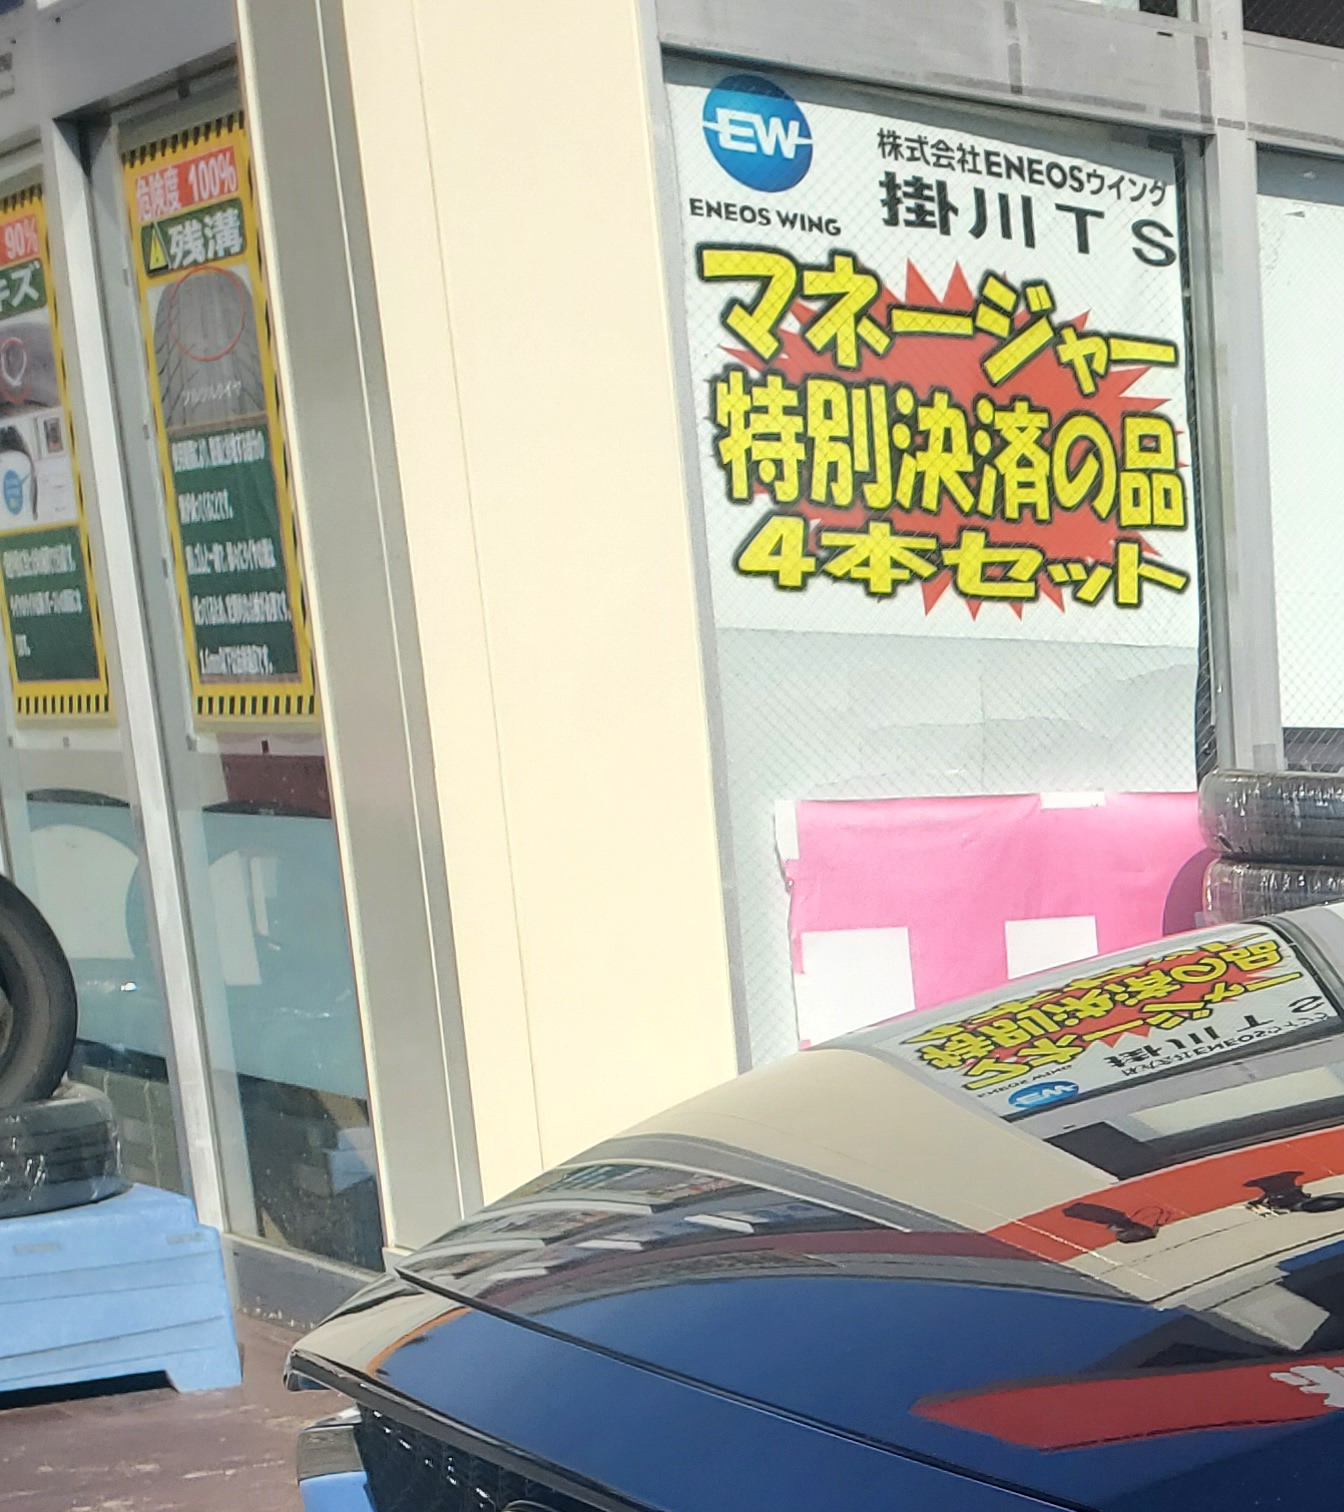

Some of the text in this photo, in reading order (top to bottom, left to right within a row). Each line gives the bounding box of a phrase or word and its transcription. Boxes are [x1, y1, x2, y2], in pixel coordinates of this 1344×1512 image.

[714, 107, 801, 160] EW
[188, 152, 238, 203] 100%
[877, 127, 1168, 207] 株式会社ENEOSウイング
[5, 217, 38, 259] 90%
[167, 207, 243, 269] 残溝
[689, 198, 842, 237] ENEOS WING
[697, 242, 1179, 397] マネージャー
[713, 366, 1188, 531] 特別決済の品
[734, 510, 1190, 608] 4本セット
